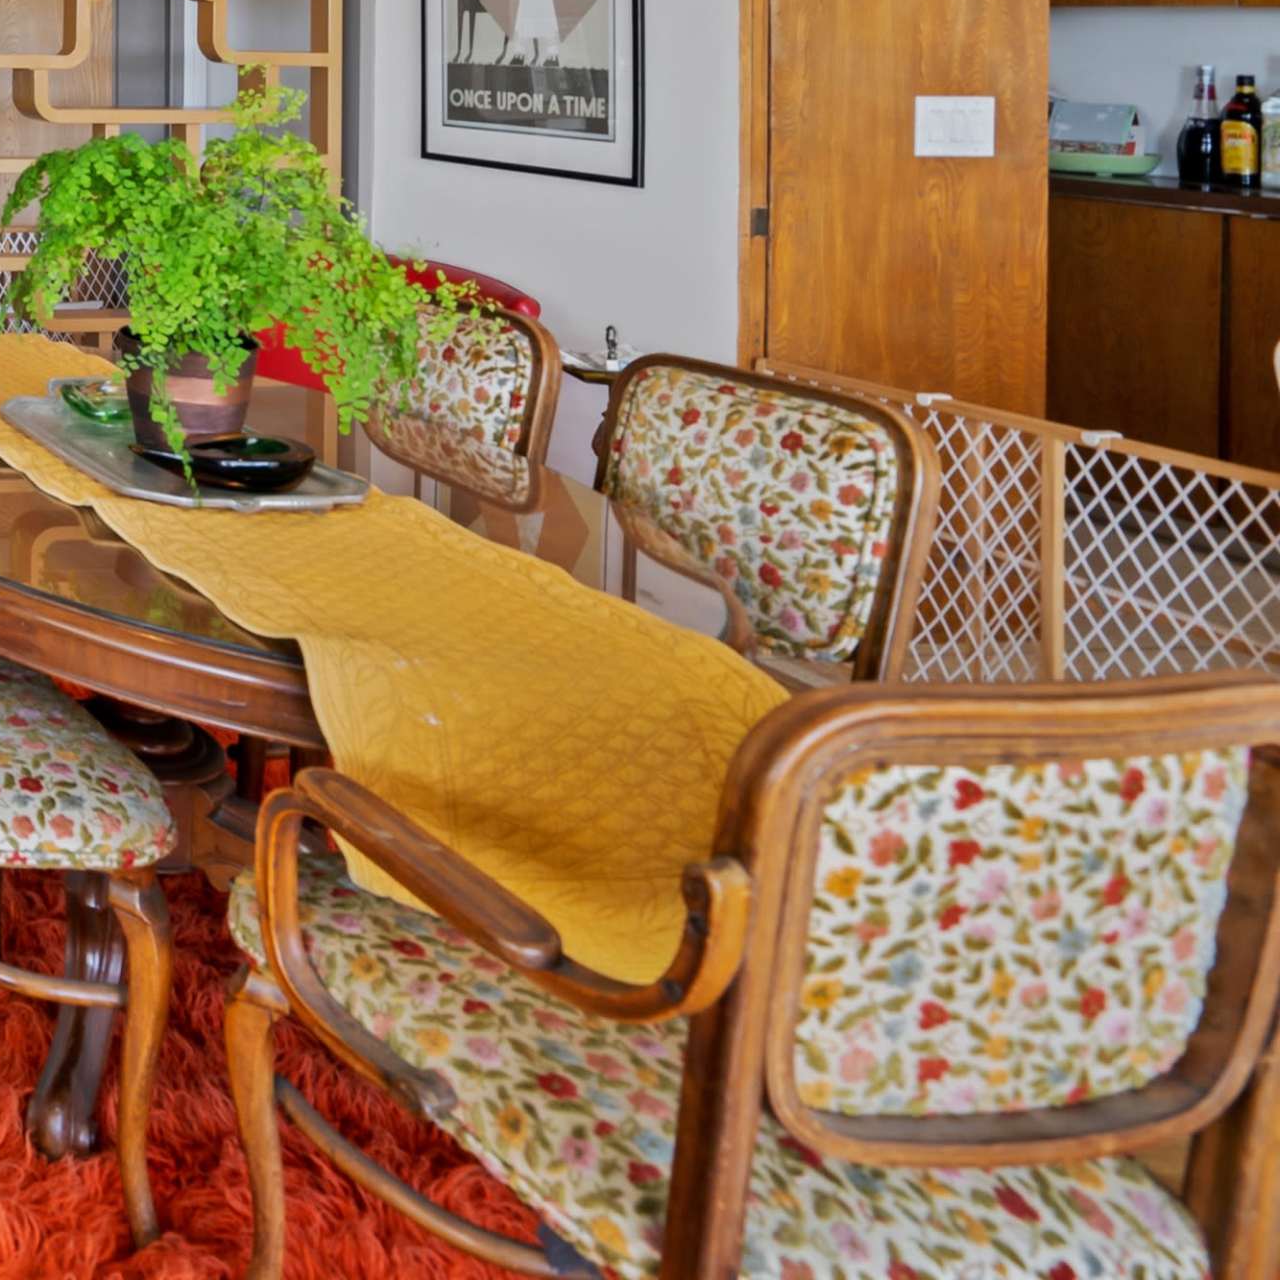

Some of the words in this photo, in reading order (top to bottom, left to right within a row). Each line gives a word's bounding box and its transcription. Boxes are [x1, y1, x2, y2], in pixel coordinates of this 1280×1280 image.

[449, 88, 492, 109] ONCE
[496, 91, 544, 114] UPON
[547, 94, 561, 115] A
[562, 95, 606, 118] TIME
